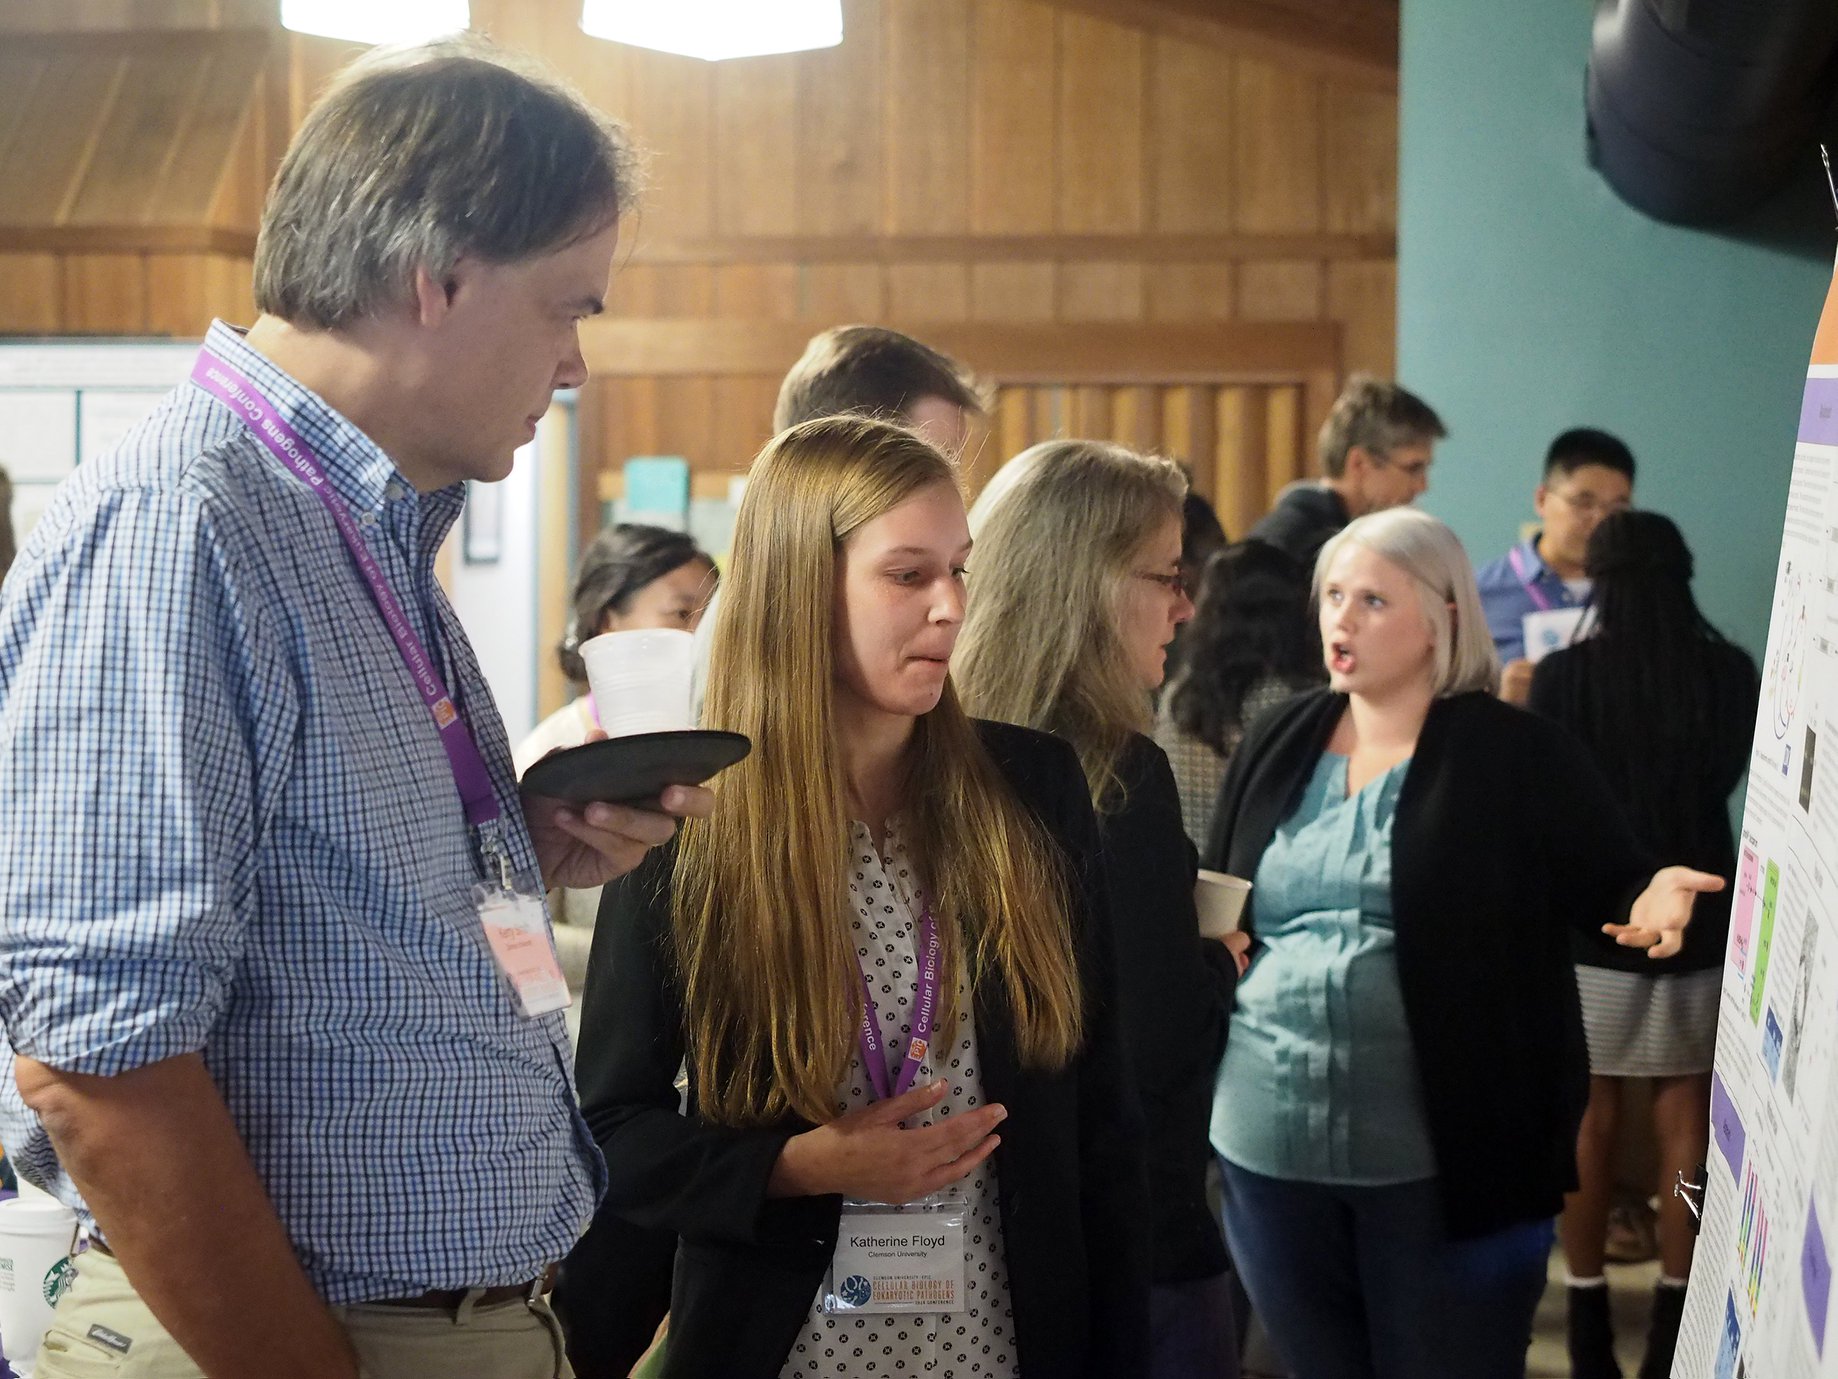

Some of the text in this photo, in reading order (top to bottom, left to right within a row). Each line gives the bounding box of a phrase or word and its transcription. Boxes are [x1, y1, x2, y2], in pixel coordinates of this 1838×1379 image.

[205, 367, 263, 421] Conference
[261, 419, 324, 486] Pathogens
[377, 584, 408, 639] Biology
[406, 641, 437, 696] Cellular
[924, 932, 940, 981] Biology
[917, 983, 933, 1033] Cellular
[850, 1235, 945, 1248] Katherine Floyd
[872, 1280, 954, 1290] CELLULAR BIOLOGY OF
[872, 1290, 955, 1300] EUKARYOTIC PATHOGENS
